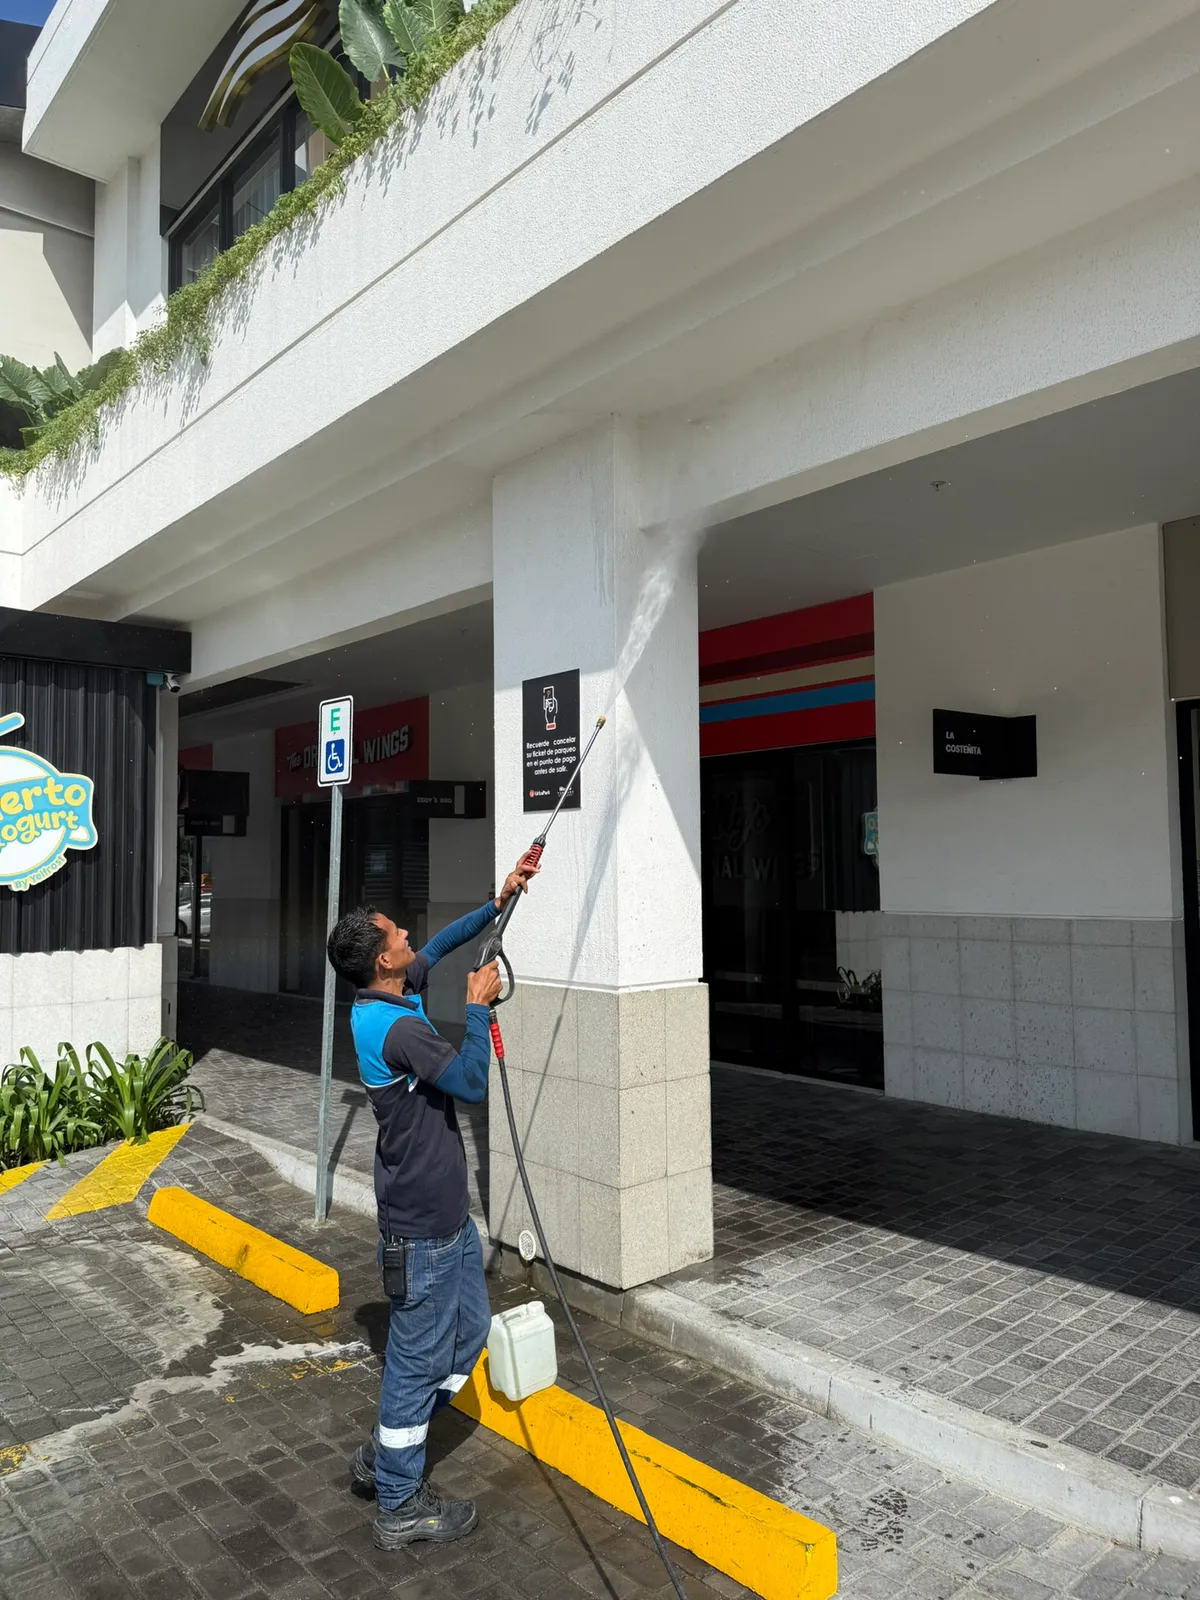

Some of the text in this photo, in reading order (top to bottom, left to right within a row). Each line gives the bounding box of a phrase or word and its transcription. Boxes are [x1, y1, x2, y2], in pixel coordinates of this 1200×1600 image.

[330, 708, 340, 731] E
[945, 731, 955, 739] LA
[363, 725, 409, 763] WINGS
[526, 737, 576, 749] Recuerde cancelar
[532, 749, 546, 757] ticket
[554, 746, 576, 756] parqueo
[945, 744, 982, 755] COSTEÑITA
[540, 757, 553, 767] punto
[562, 756, 576, 764] pago
[534, 767, 548, 775] antes
[548, 766, 555, 774] de
[0, 777, 86, 815] erto
[0, 811, 78, 843] ogurt
[15, 878, 29, 889] By
